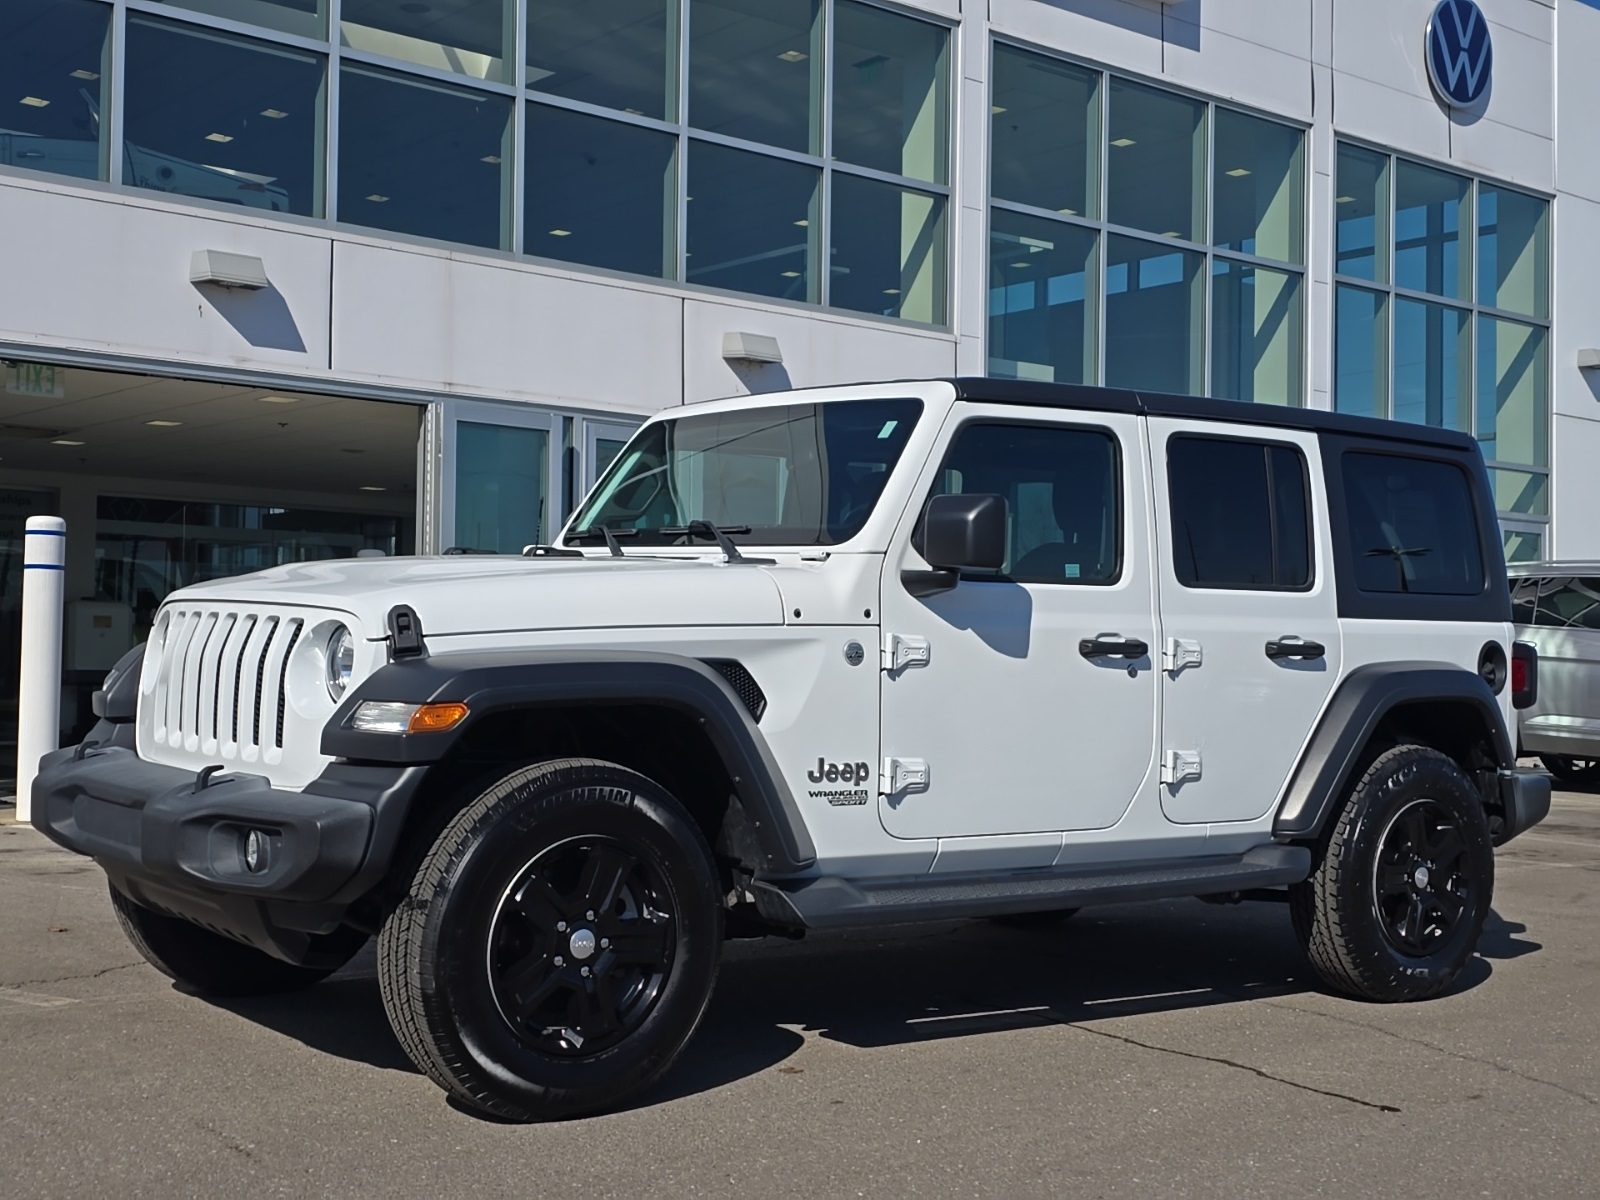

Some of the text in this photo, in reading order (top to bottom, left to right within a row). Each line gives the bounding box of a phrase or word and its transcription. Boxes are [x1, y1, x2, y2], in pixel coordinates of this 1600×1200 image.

[1431, 0, 1490, 100] VW
[807, 757, 869, 786] Jeep
[808, 790, 868, 798] WRANGLER
